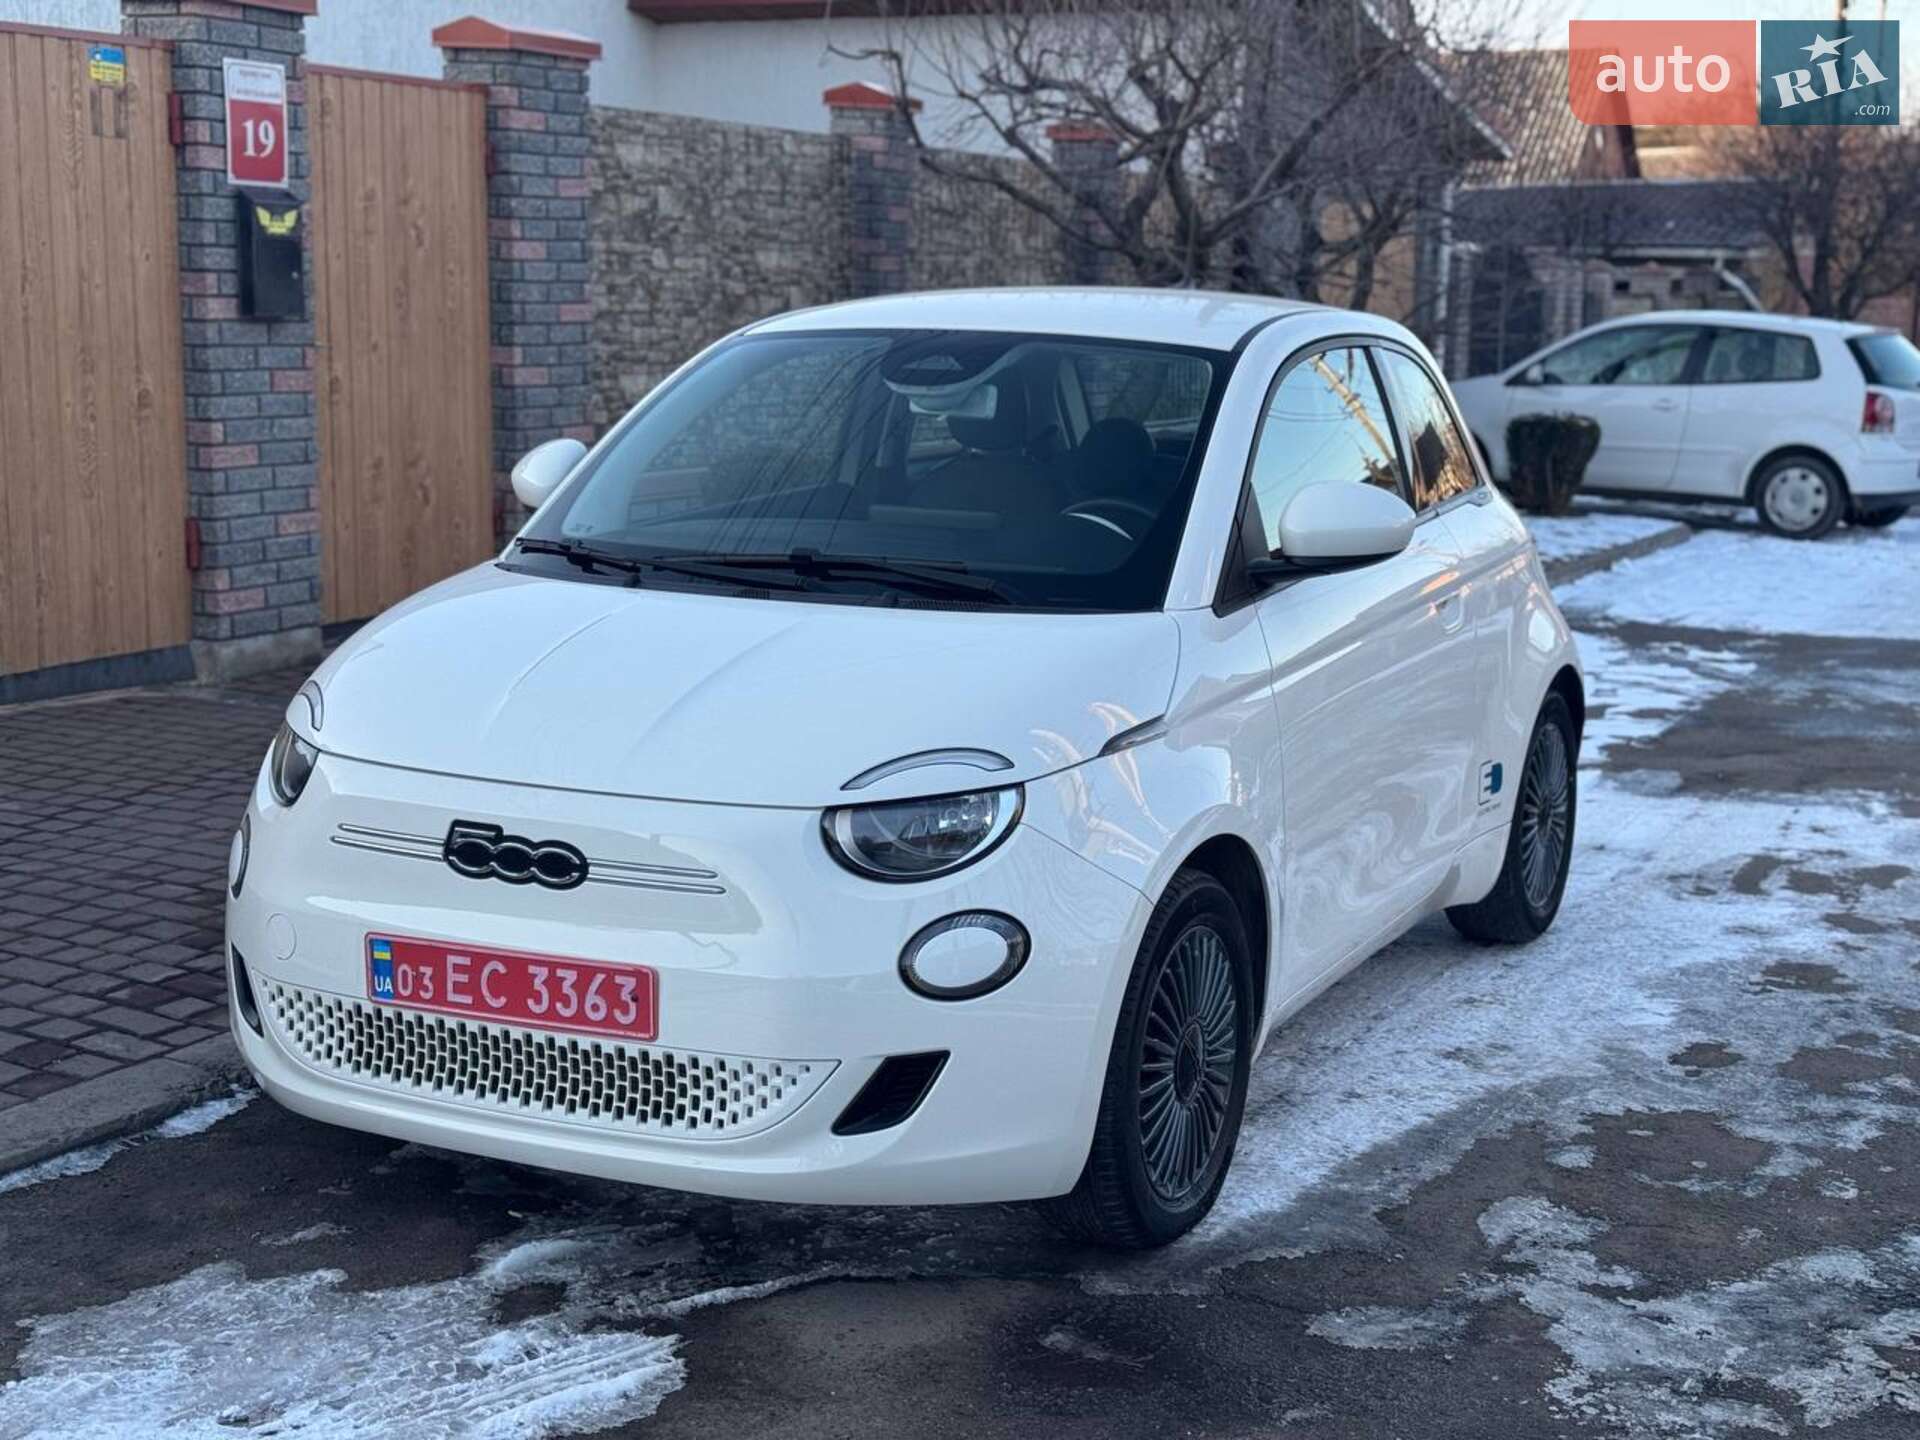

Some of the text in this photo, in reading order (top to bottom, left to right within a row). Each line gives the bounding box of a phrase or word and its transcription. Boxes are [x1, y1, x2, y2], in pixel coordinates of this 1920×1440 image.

[241, 119, 276, 158] 19
[444, 819, 590, 891] 500
[374, 954, 638, 1026] UA 03 EC 3363
